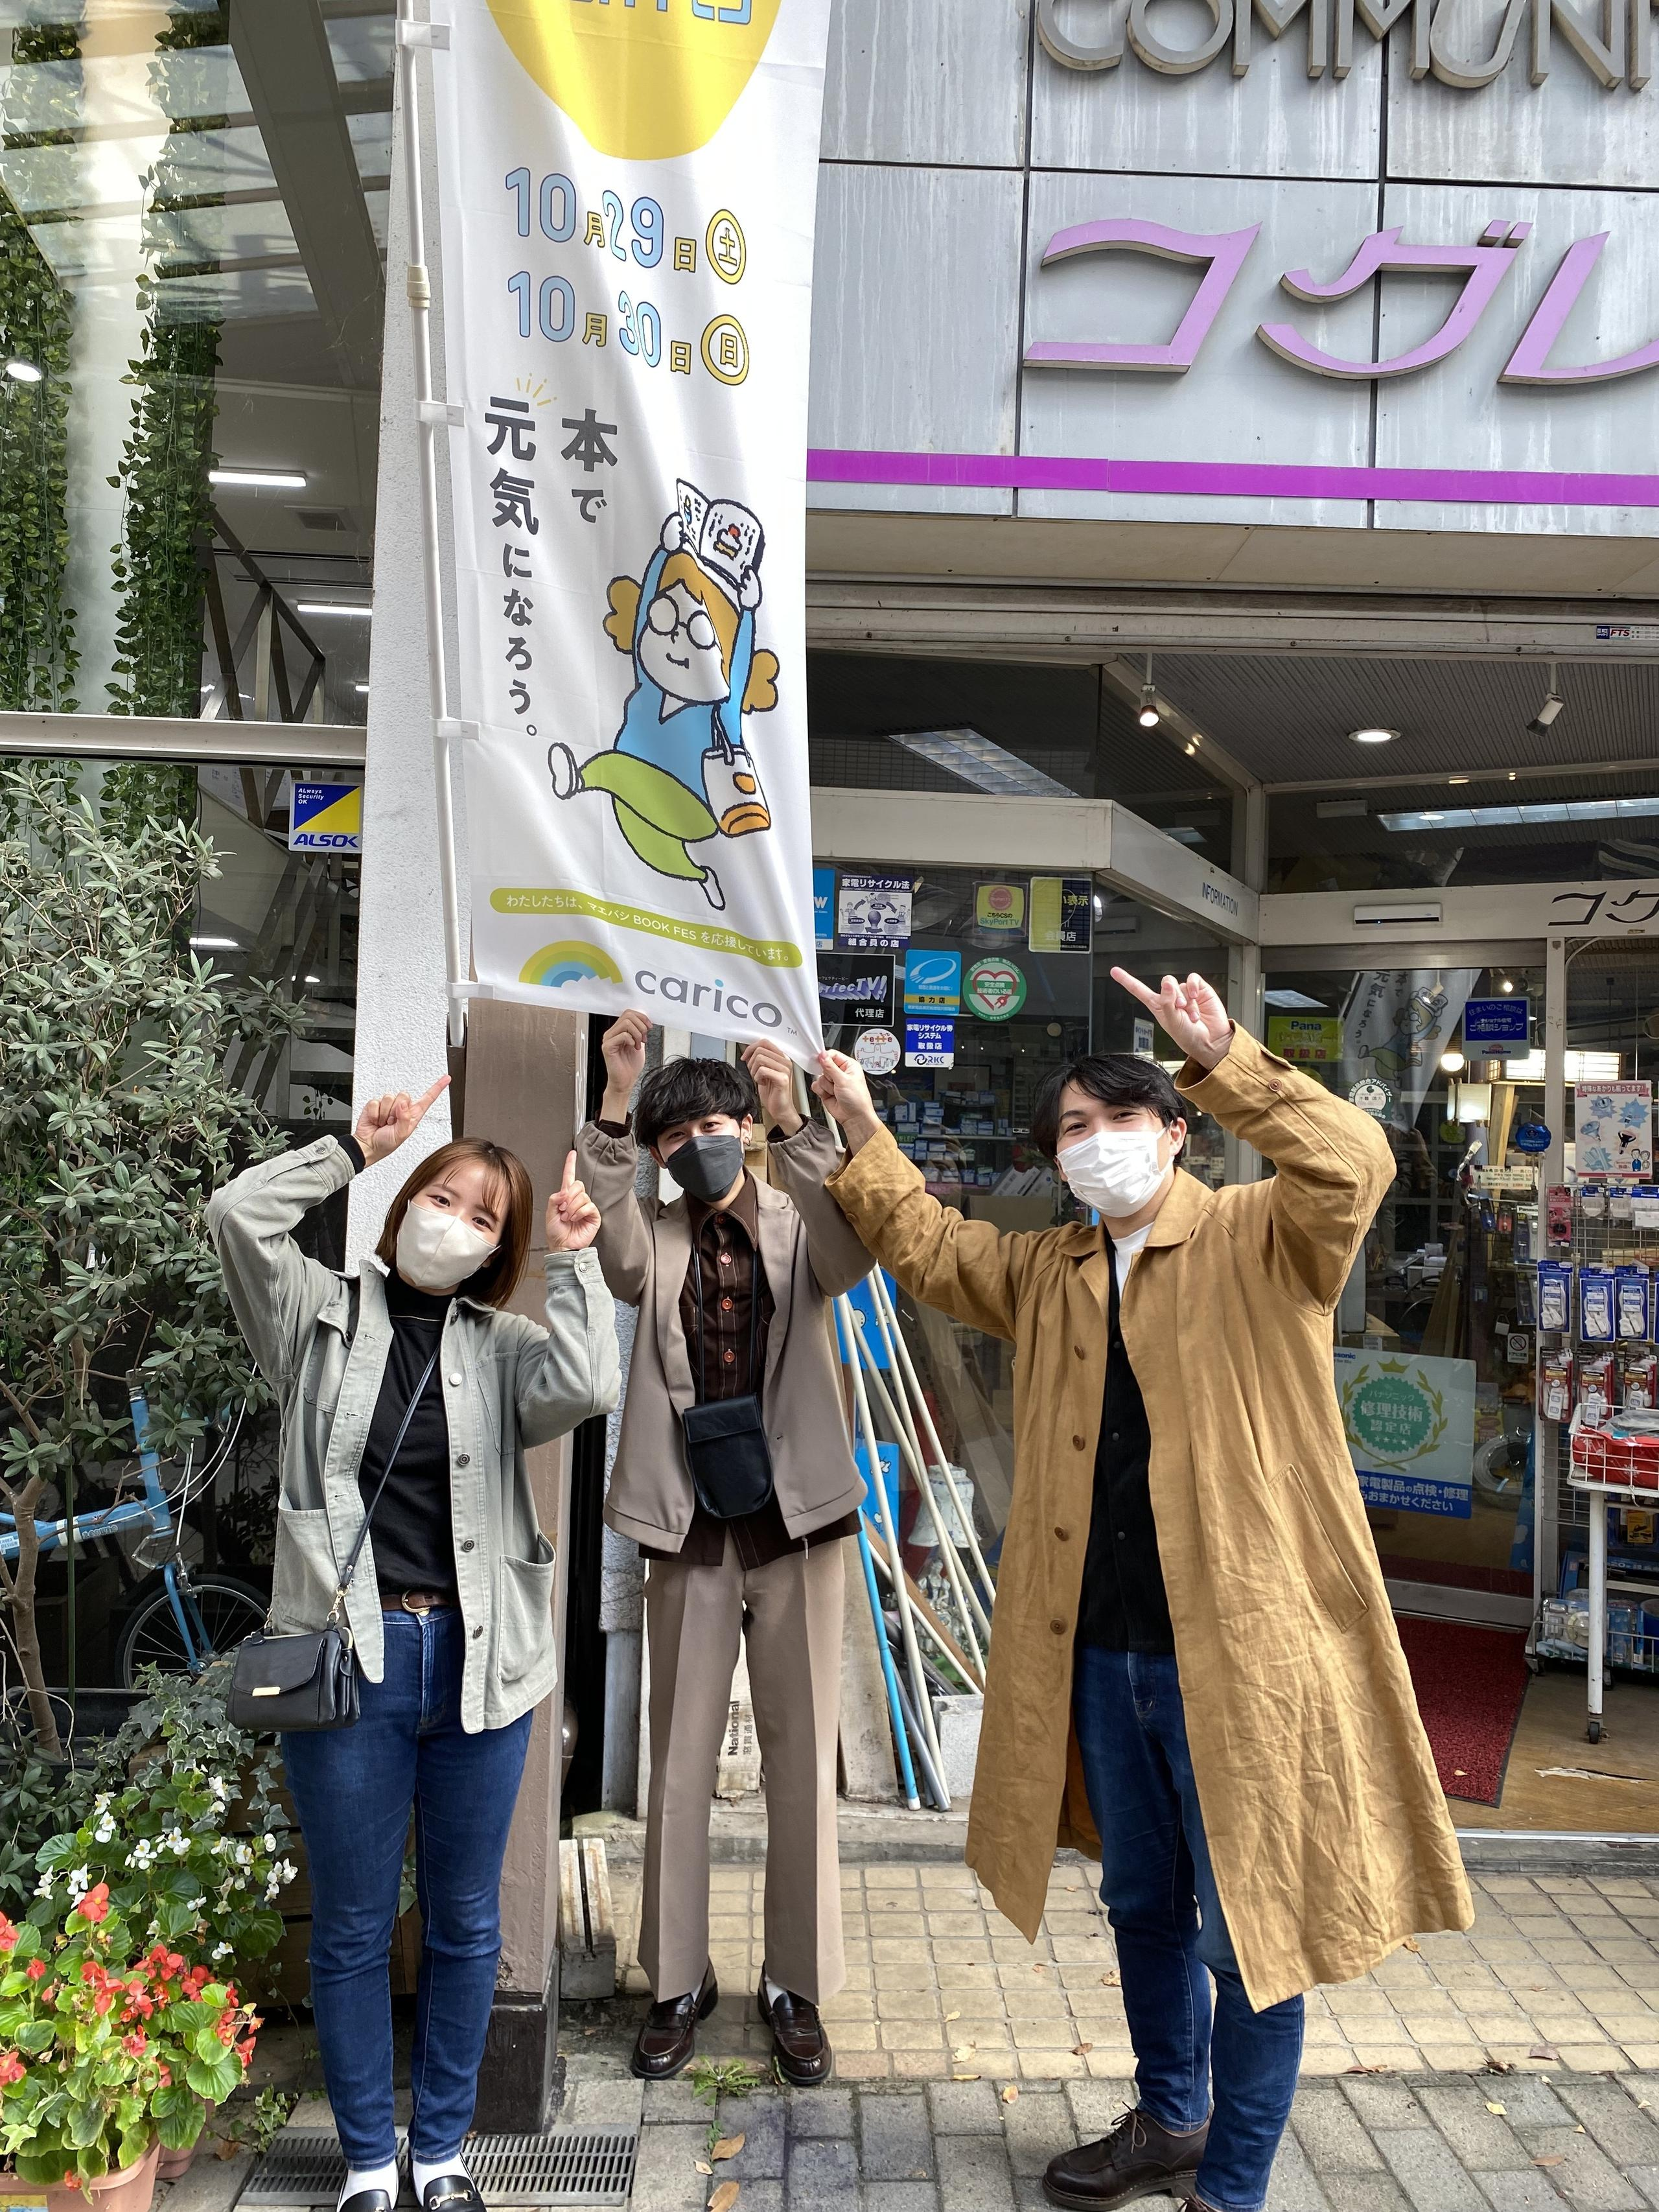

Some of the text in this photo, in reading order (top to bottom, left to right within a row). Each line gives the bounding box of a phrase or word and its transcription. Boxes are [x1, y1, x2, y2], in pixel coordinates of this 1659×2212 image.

[1036, 0, 1659, 89] COMMUNI
[560, 409, 618, 524] 本で
[484, 396, 539, 737] 元気になろう。
[293, 833, 359, 848] ALSOK
[842, 878, 911, 890] 家電リサイクル法
[980, 918, 1008, 926] SkyPort
[633, 914, 670, 933] BOOK
[673, 926, 697, 940] FES
[701, 931, 789, 962] を応援しています。
[848, 938, 899, 948] 組合員の店
[634, 970, 783, 1028] carico
[918, 995, 946, 1004] 協力店
[855, 1008, 885, 1019] 代理店
[907, 1024, 953, 1032] 家電リサイクル券
[1290, 1020, 1323, 1031] Pana
[918, 1032, 942, 1040] システム
[1282, 1047, 1327, 1060] 取扱店
[928, 1056, 944, 1064] RKC
[1369, 1390, 1415, 1401] パナソニック
[1360, 1400, 1424, 1423] 修理技術
[1370, 1419, 1411, 1436] 認定店
[727, 1700, 740, 1756] National
